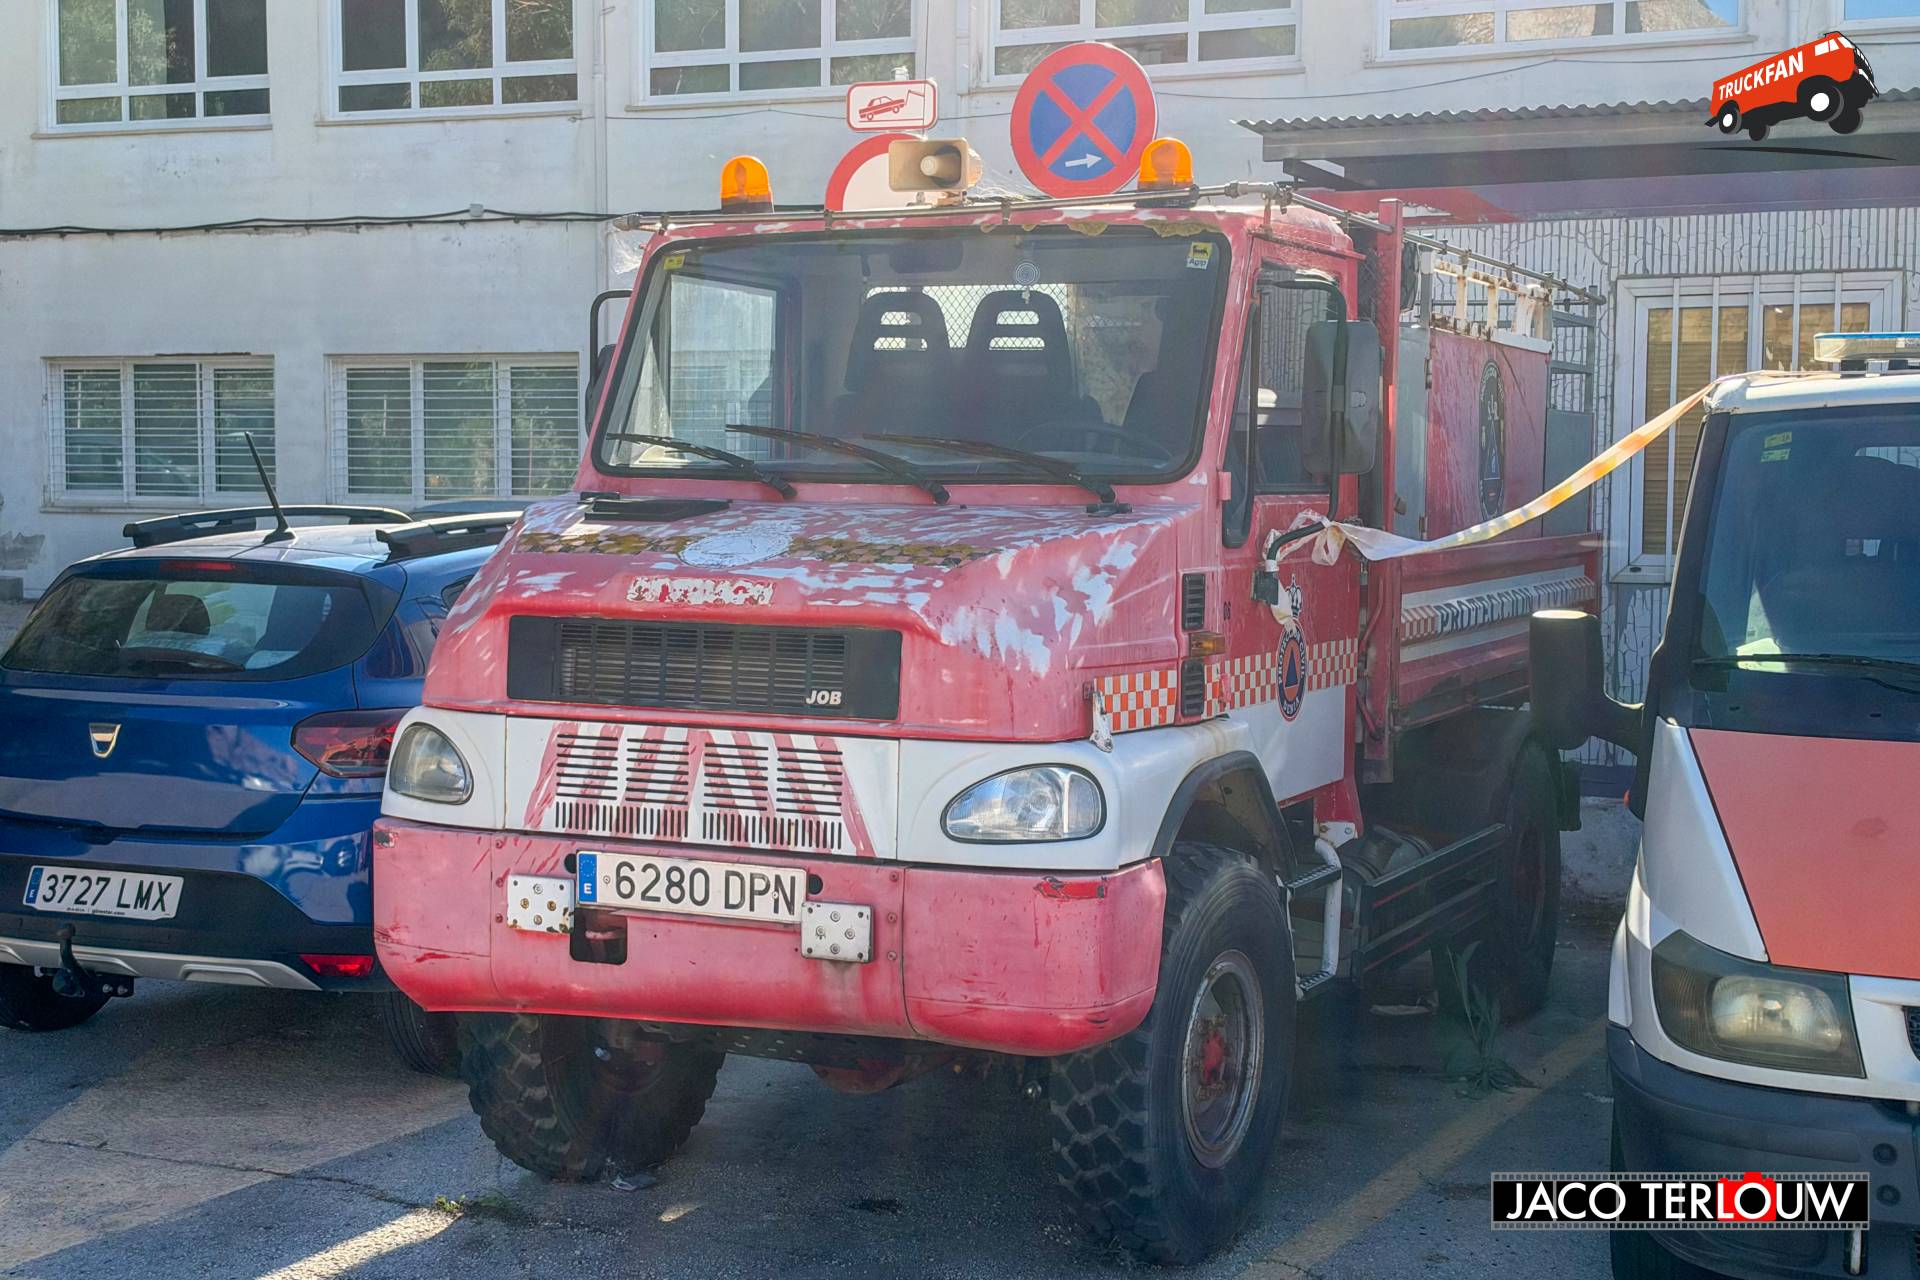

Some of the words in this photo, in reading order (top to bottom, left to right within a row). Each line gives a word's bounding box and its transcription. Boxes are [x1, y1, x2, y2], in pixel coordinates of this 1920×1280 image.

[805, 690, 842, 705] JOB
[29, 889, 35, 898] E
[42, 874, 111, 906] 3727
[116, 878, 172, 912] LMX
[583, 883, 592, 894] E
[615, 861, 710, 906] 6280
[724, 870, 796, 916] DPN
